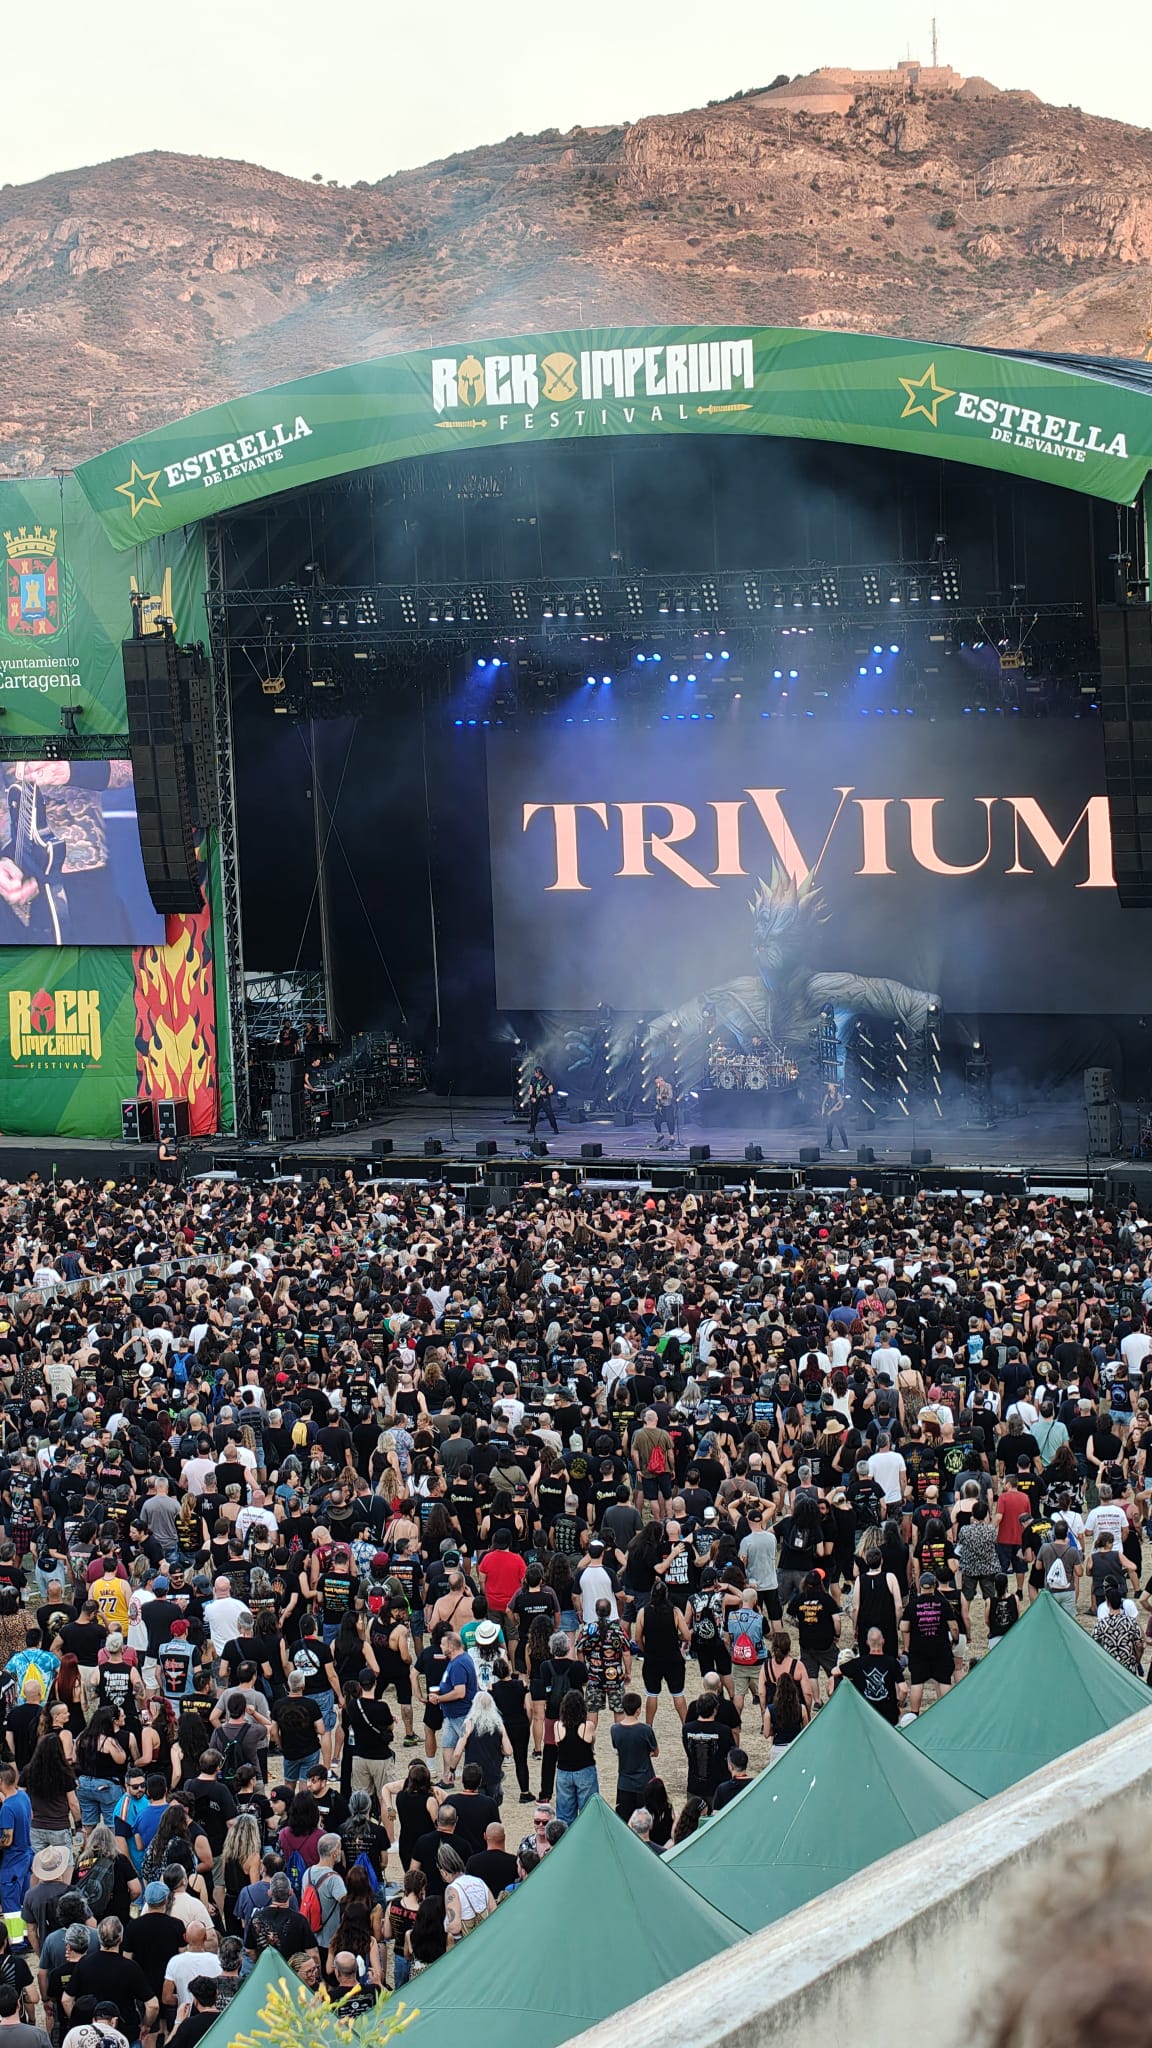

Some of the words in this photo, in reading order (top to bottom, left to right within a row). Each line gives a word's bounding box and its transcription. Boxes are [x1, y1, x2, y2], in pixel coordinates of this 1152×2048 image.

[580, 340, 754, 401] IMPERIUM
[499, 403, 689, 430] FESTIVAL
[955, 392, 1129, 459] ESTRELLA
[163, 415, 313, 488] ESTRELLA
[990, 427, 1013, 443] DE
[1014, 433, 1087, 464] LEVANTE
[202, 473, 223, 488] DE
[224, 448, 284, 480] LEVANTE
[0, 656, 80, 672] yuntamiento
[521, 786, 1118, 890] TRIVIUM
[21, 1034, 91, 1056] IMPERIUM
[30, 1061, 87, 1070] FESTIVAL
[99, 1597, 117, 1613] 77
